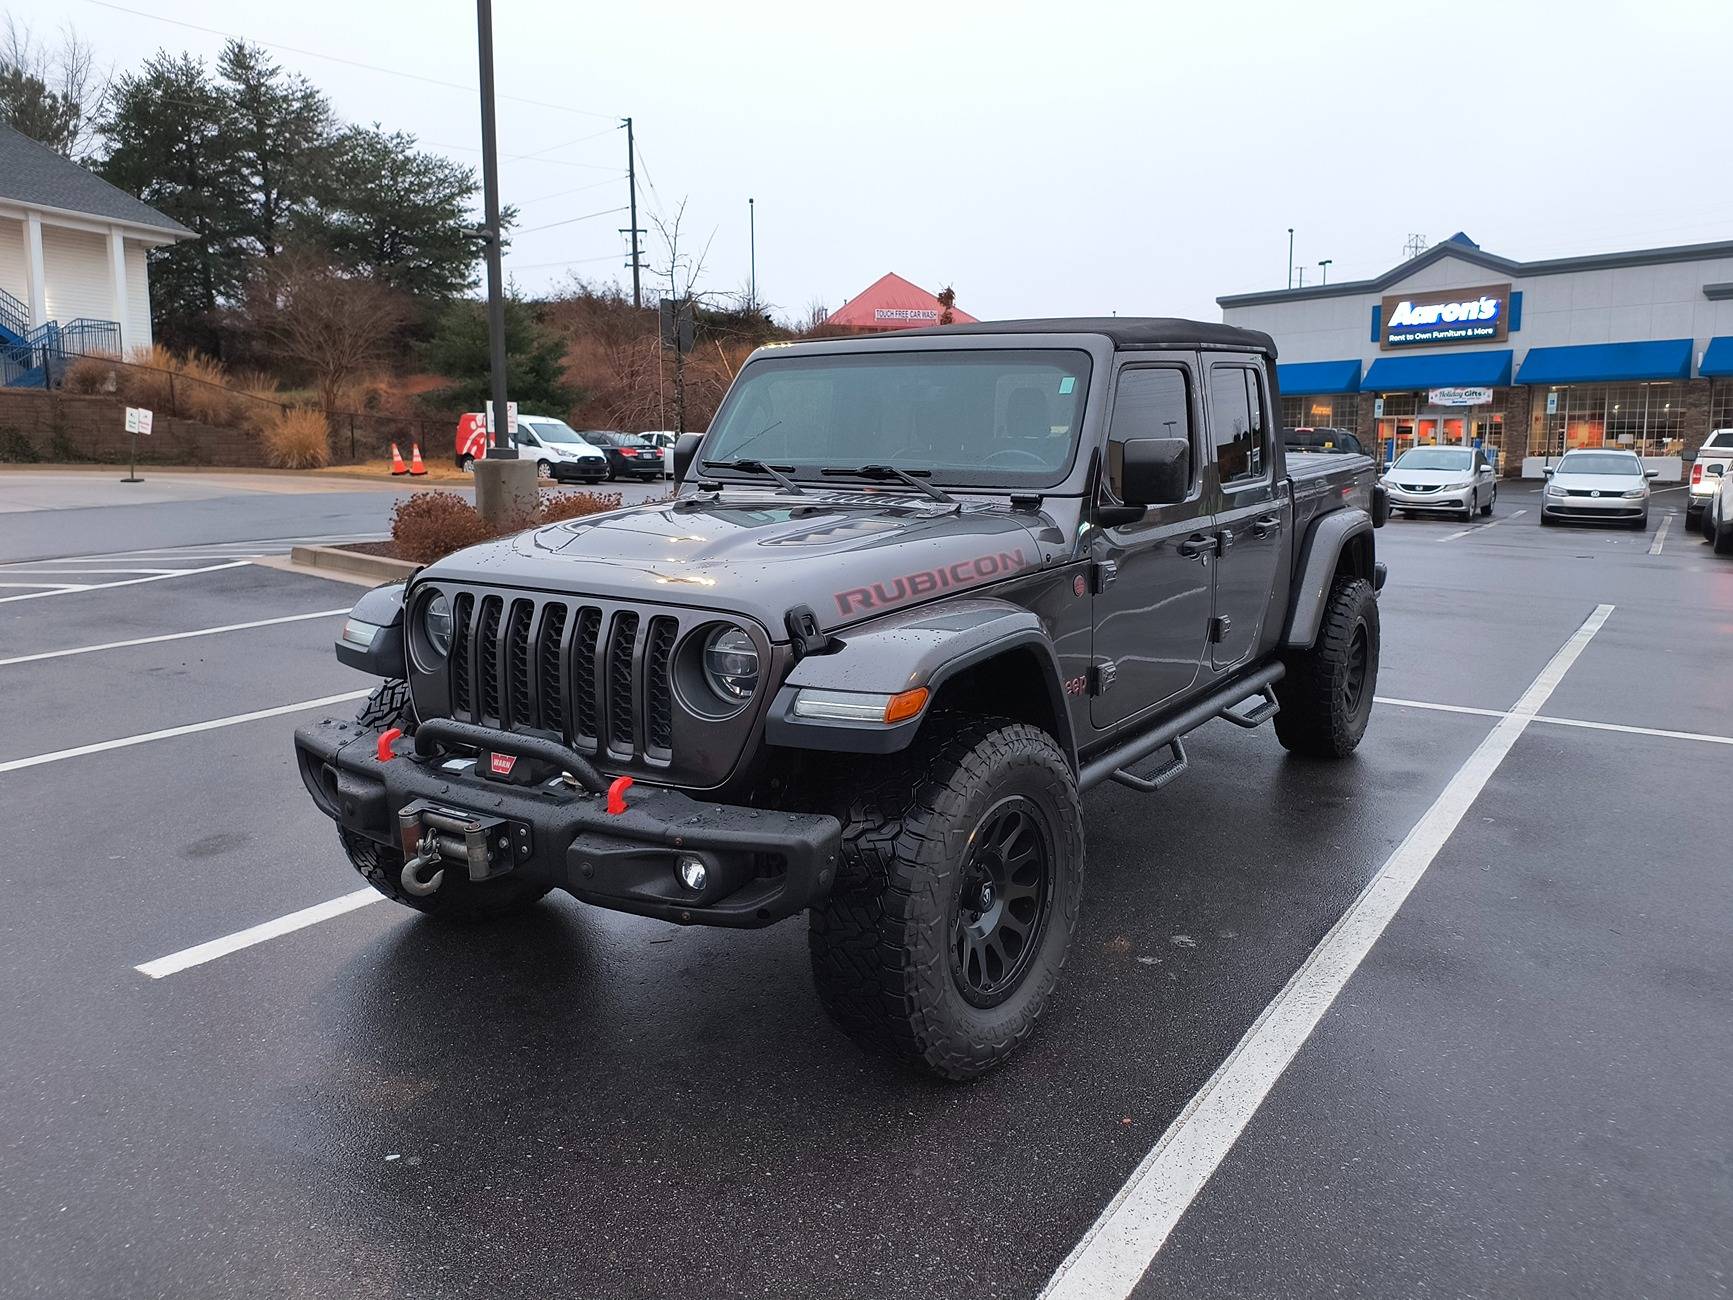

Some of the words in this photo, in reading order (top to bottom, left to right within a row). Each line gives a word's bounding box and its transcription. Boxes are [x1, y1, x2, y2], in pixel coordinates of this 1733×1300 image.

[876, 309, 894, 319] TOUCH
[895, 310, 909, 319] FREE
[910, 310, 921, 319] CAR
[922, 310, 937, 319] WASH
[1388, 296, 1497, 326] Aaron's
[1406, 333, 1414, 341] to
[1415, 332, 1431, 340] Own
[1433, 329, 1466, 339] Furniture
[1439, 390, 1463, 399] Holiday
[1464, 389, 1482, 398] Gifts
[834, 547, 1026, 617] RUBICON
[1064, 675, 1087, 696] eep
[494, 758, 510, 768] WARN
